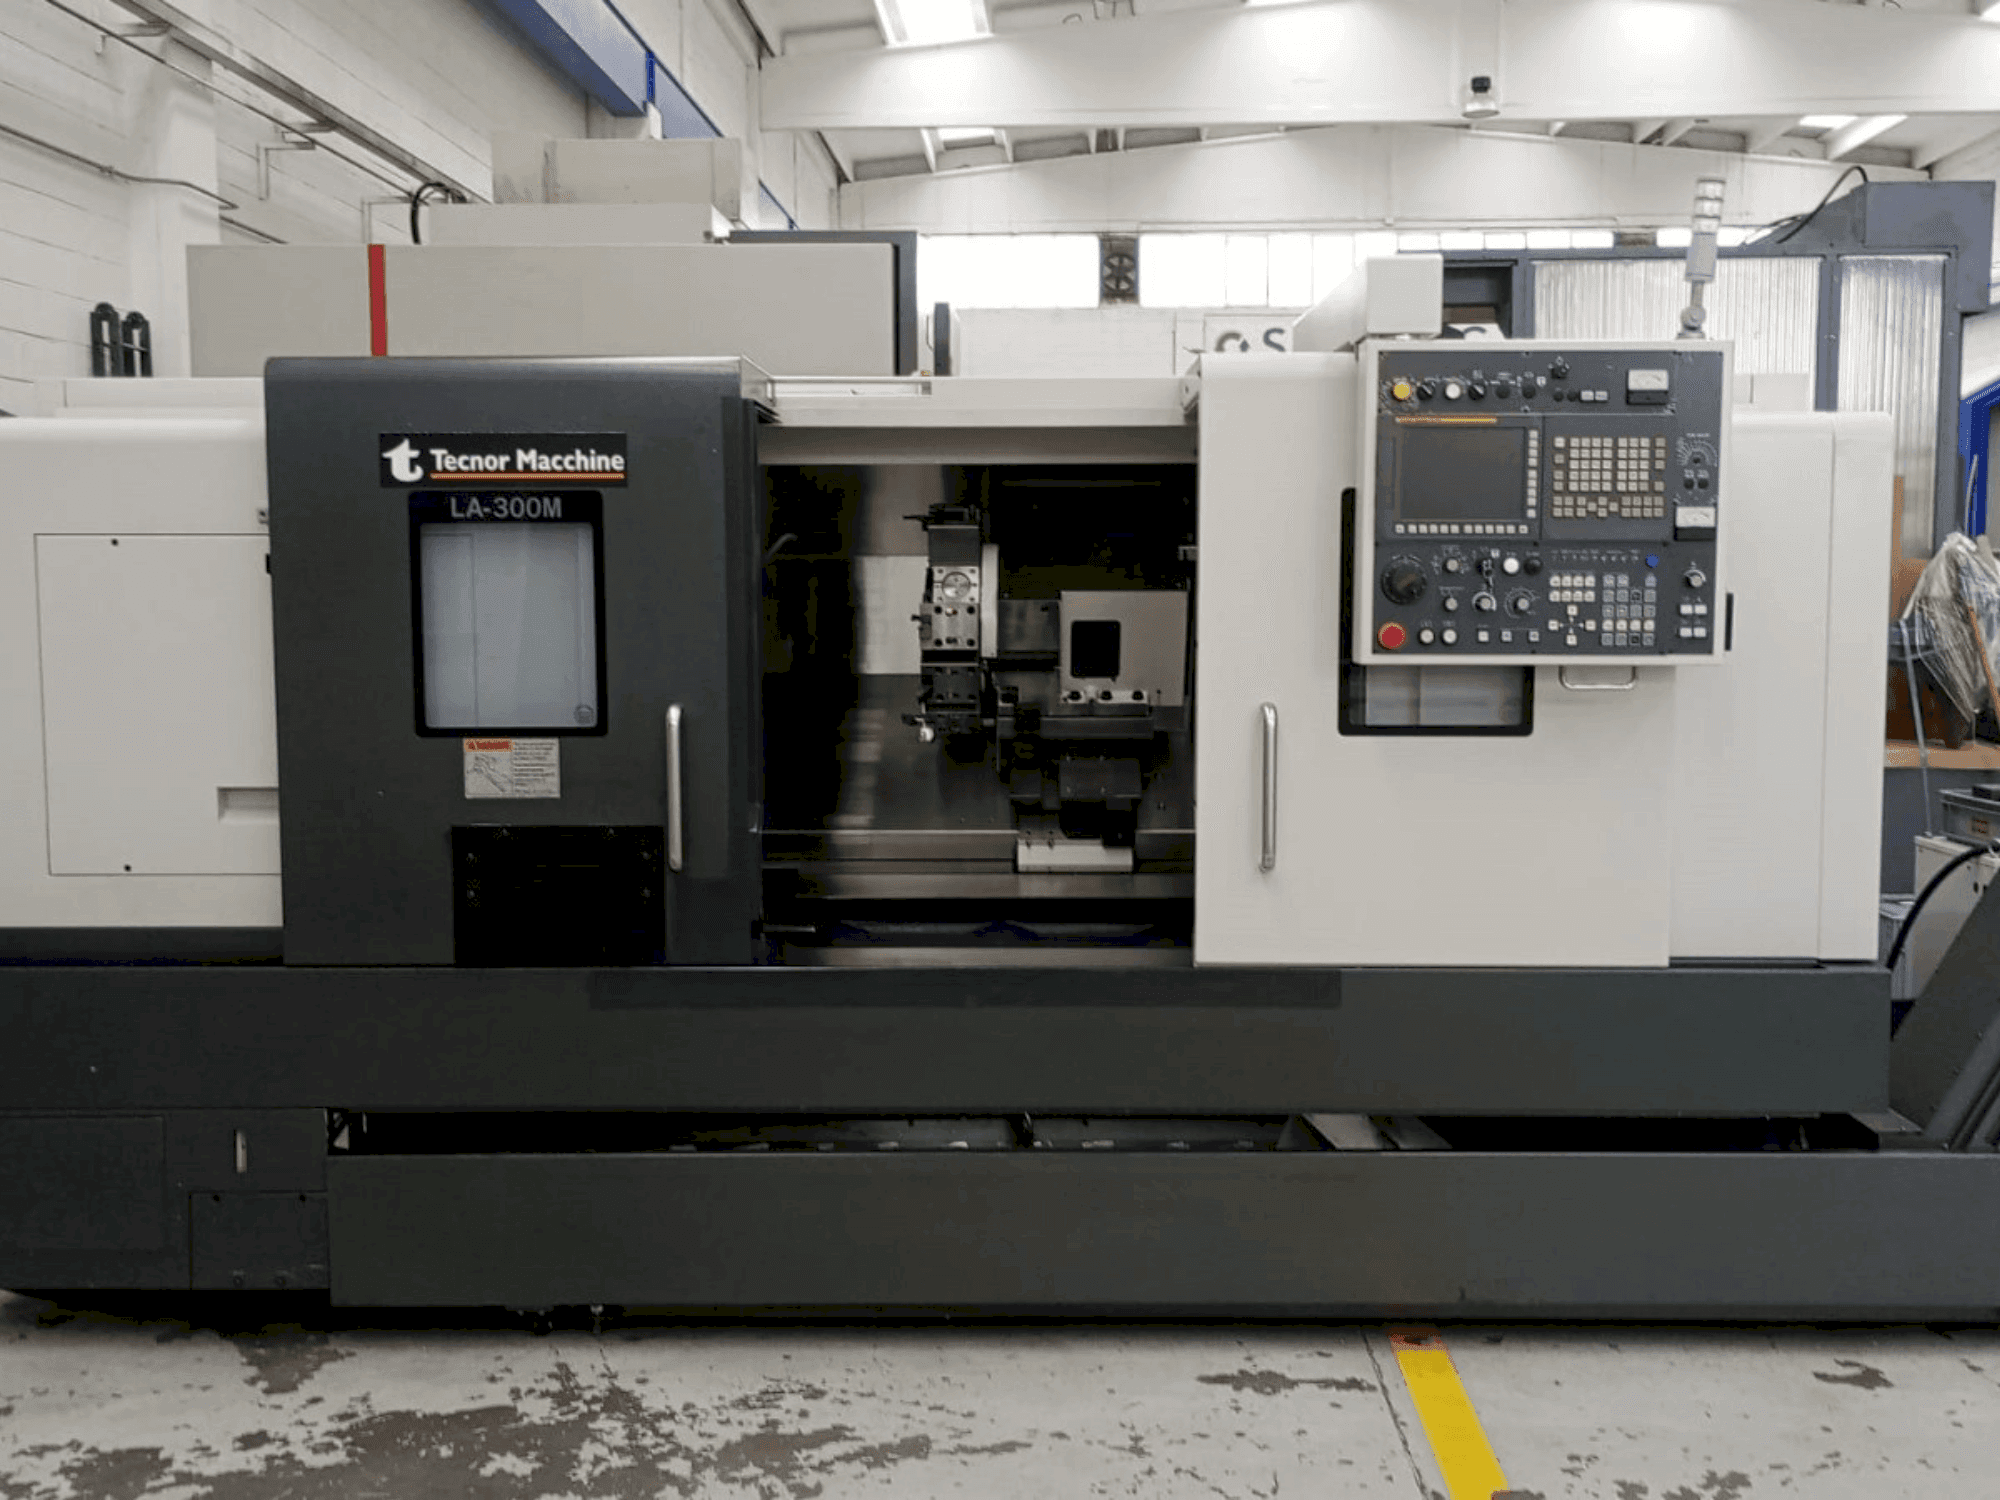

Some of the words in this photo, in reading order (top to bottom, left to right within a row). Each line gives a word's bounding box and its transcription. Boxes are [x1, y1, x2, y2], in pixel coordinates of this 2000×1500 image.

[429, 448, 511, 472] Tecnor
[515, 448, 625, 472] Macchine
[450, 497, 563, 519] LA-300M
